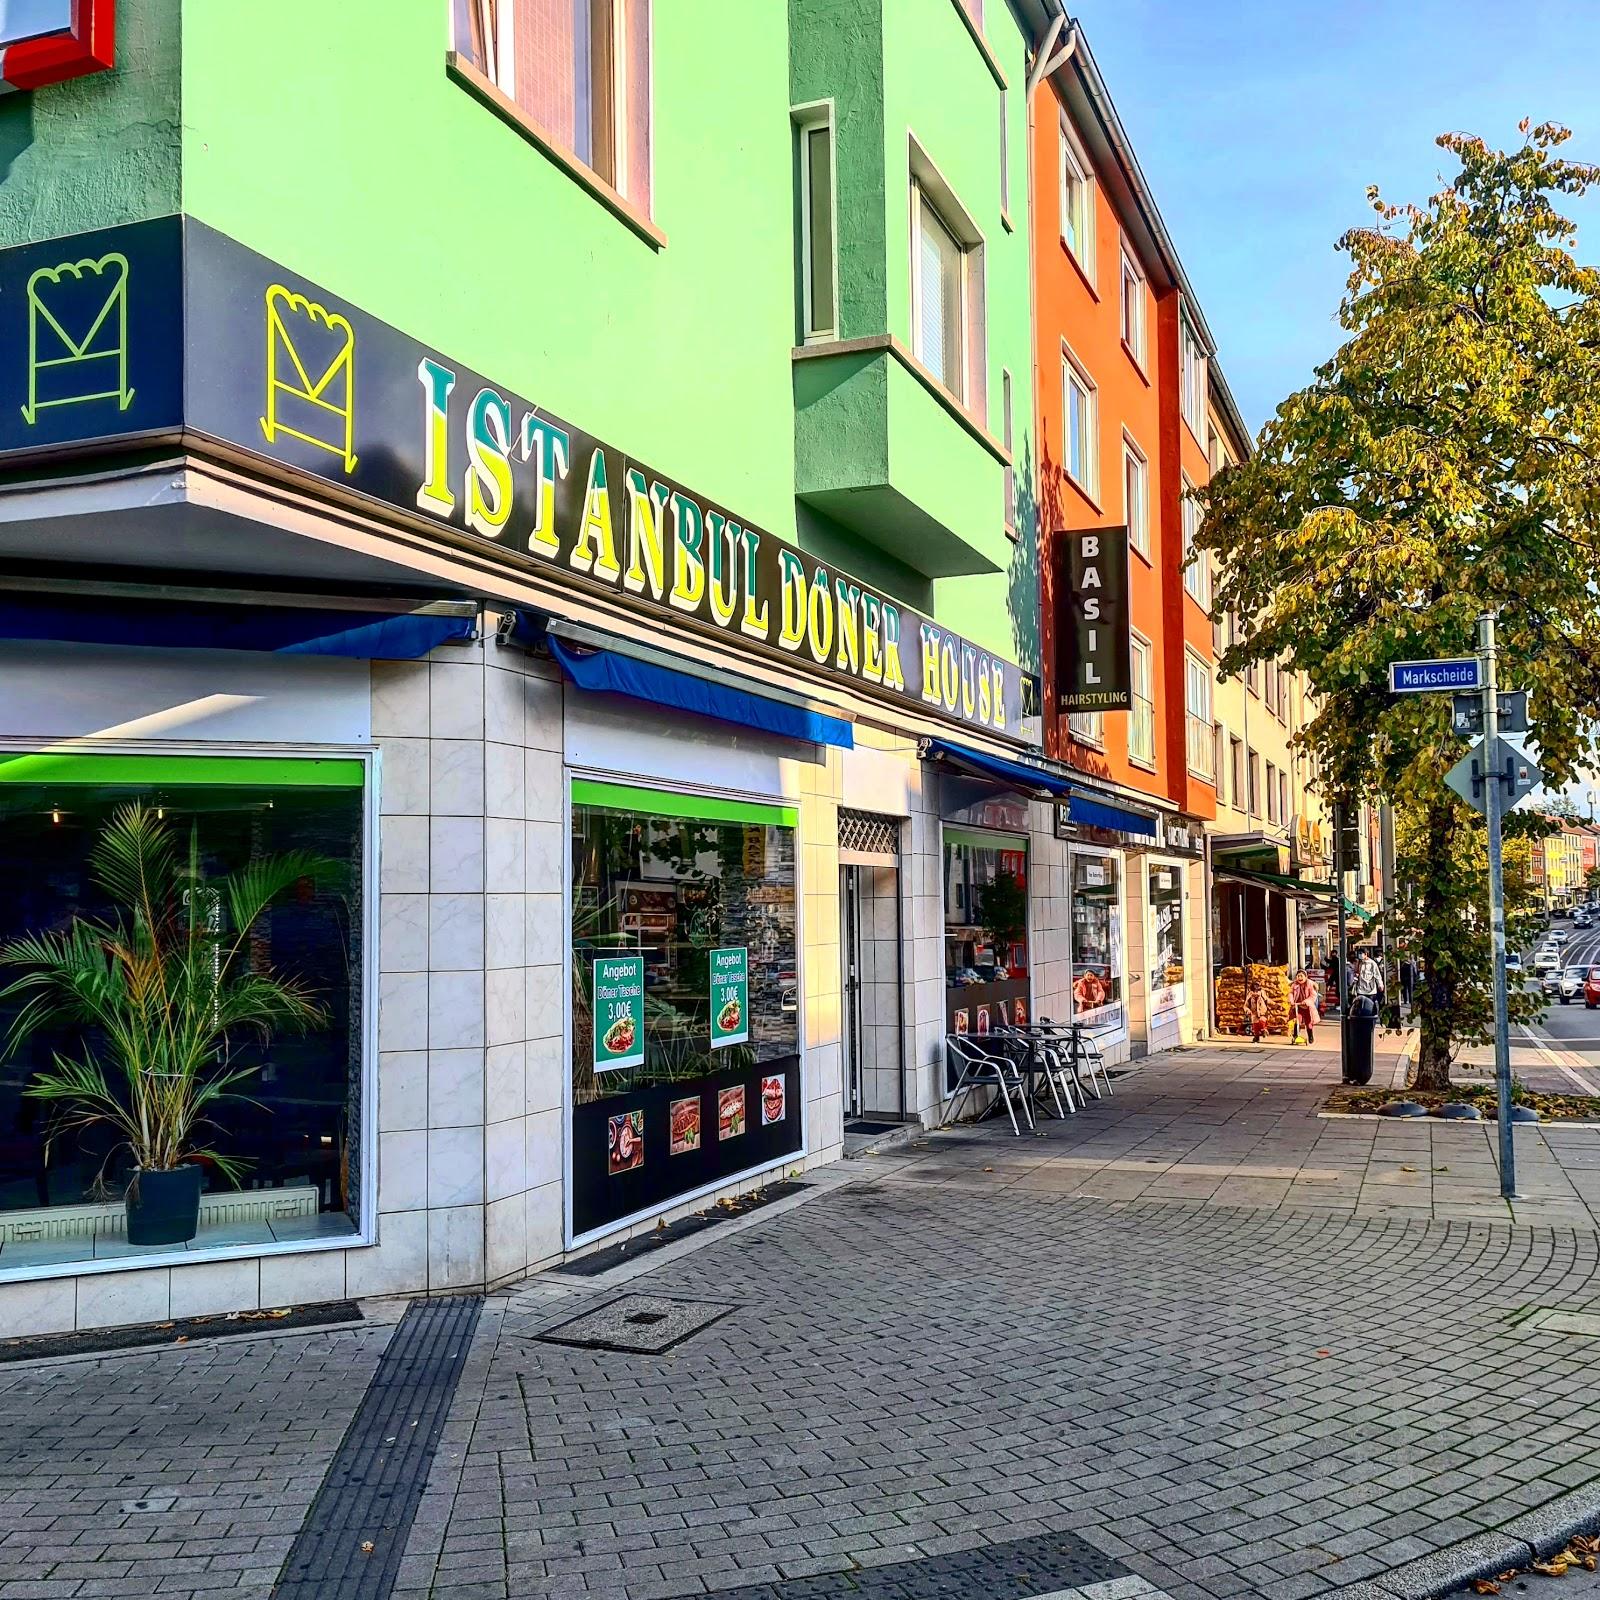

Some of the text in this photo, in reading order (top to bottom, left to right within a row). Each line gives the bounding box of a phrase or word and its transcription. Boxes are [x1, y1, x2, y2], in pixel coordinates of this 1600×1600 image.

[416, 357, 1006, 730] ISTANBUL DÖNER HOUSE
[1081, 535, 1102, 684] BASIL
[1403, 668, 1474, 685] Markscheide
[1061, 691, 1127, 706] HAIRSTYLING
[715, 952, 742, 968] Angebot
[602, 963, 637, 981] Angebot
[712, 972, 729, 985] Döner
[597, 983, 641, 1000] Döner Tasche
[720, 986, 738, 1003] 3,00€
[607, 1002, 632, 1021] 3,00€
